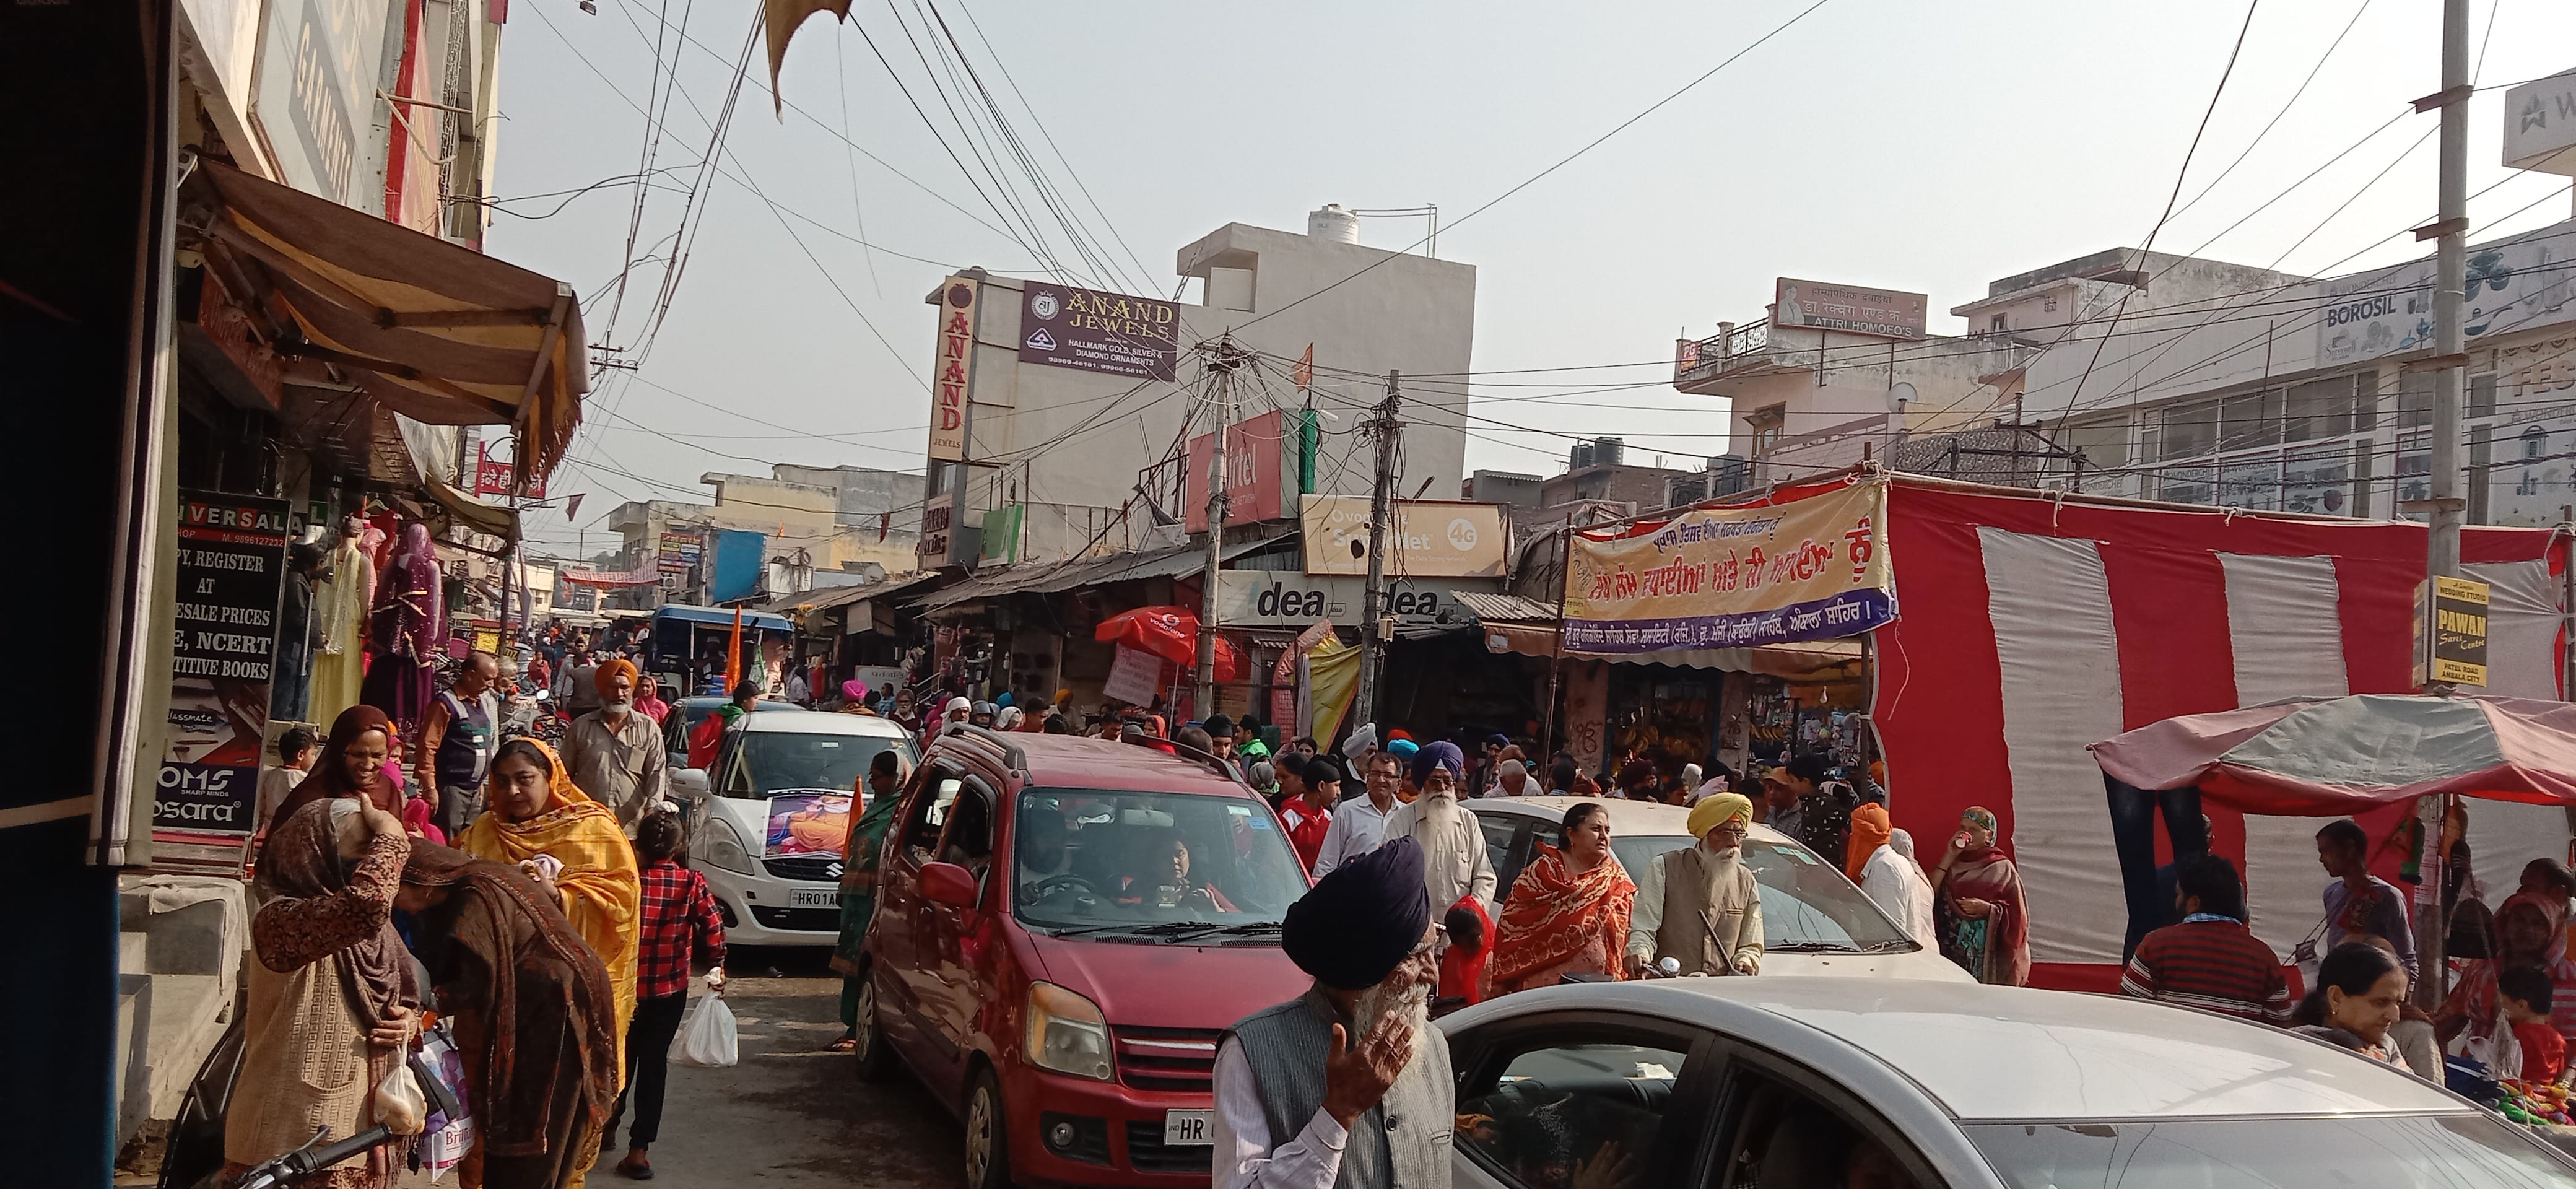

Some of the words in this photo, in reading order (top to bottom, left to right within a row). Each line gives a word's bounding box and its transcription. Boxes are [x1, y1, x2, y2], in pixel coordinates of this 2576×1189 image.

[1066, 293, 1173, 324] ANAND
[2328, 296, 2396, 328] BOROSIL
[1070, 314, 1169, 340] JEWELS
[1815, 318, 1847, 329] ATTRI
[1068, 339, 1107, 351] HALLMARK
[1133, 348, 1155, 358] SILVER
[1076, 349, 1109, 360] DIAMOND
[1110, 354, 1154, 367] ORNAMENTS
[940, 311, 970, 431] ANAND
[933, 438, 961, 449] JEWELS
[222, 534, 232, 542] M.
[235, 534, 284, 547] 9896127232
[1450, 523, 1475, 543] 4G
[195, 550, 264, 572] REGISTER
[196, 578, 215, 594] AT
[2440, 588, 2465, 599] WEDDING
[2466, 591, 2486, 602] STUDIO
[222, 605, 270, 627] PRICES
[2439, 609, 2487, 637] PAWAN
[1149, 617, 1186, 639] vodafone
[196, 631, 271, 655] NCERT
[2461, 639, 2485, 650] Centre
[222, 661, 269, 680] BOOKS
[2442, 671, 2465, 681] AMBALA
[2467, 674, 2480, 682] CITY
[2444, 663, 2461, 673] PATEL
[2463, 666, 2479, 674] ROAD
[798, 892, 835, 905] HR01A
[1180, 1118, 1204, 1139] HR
